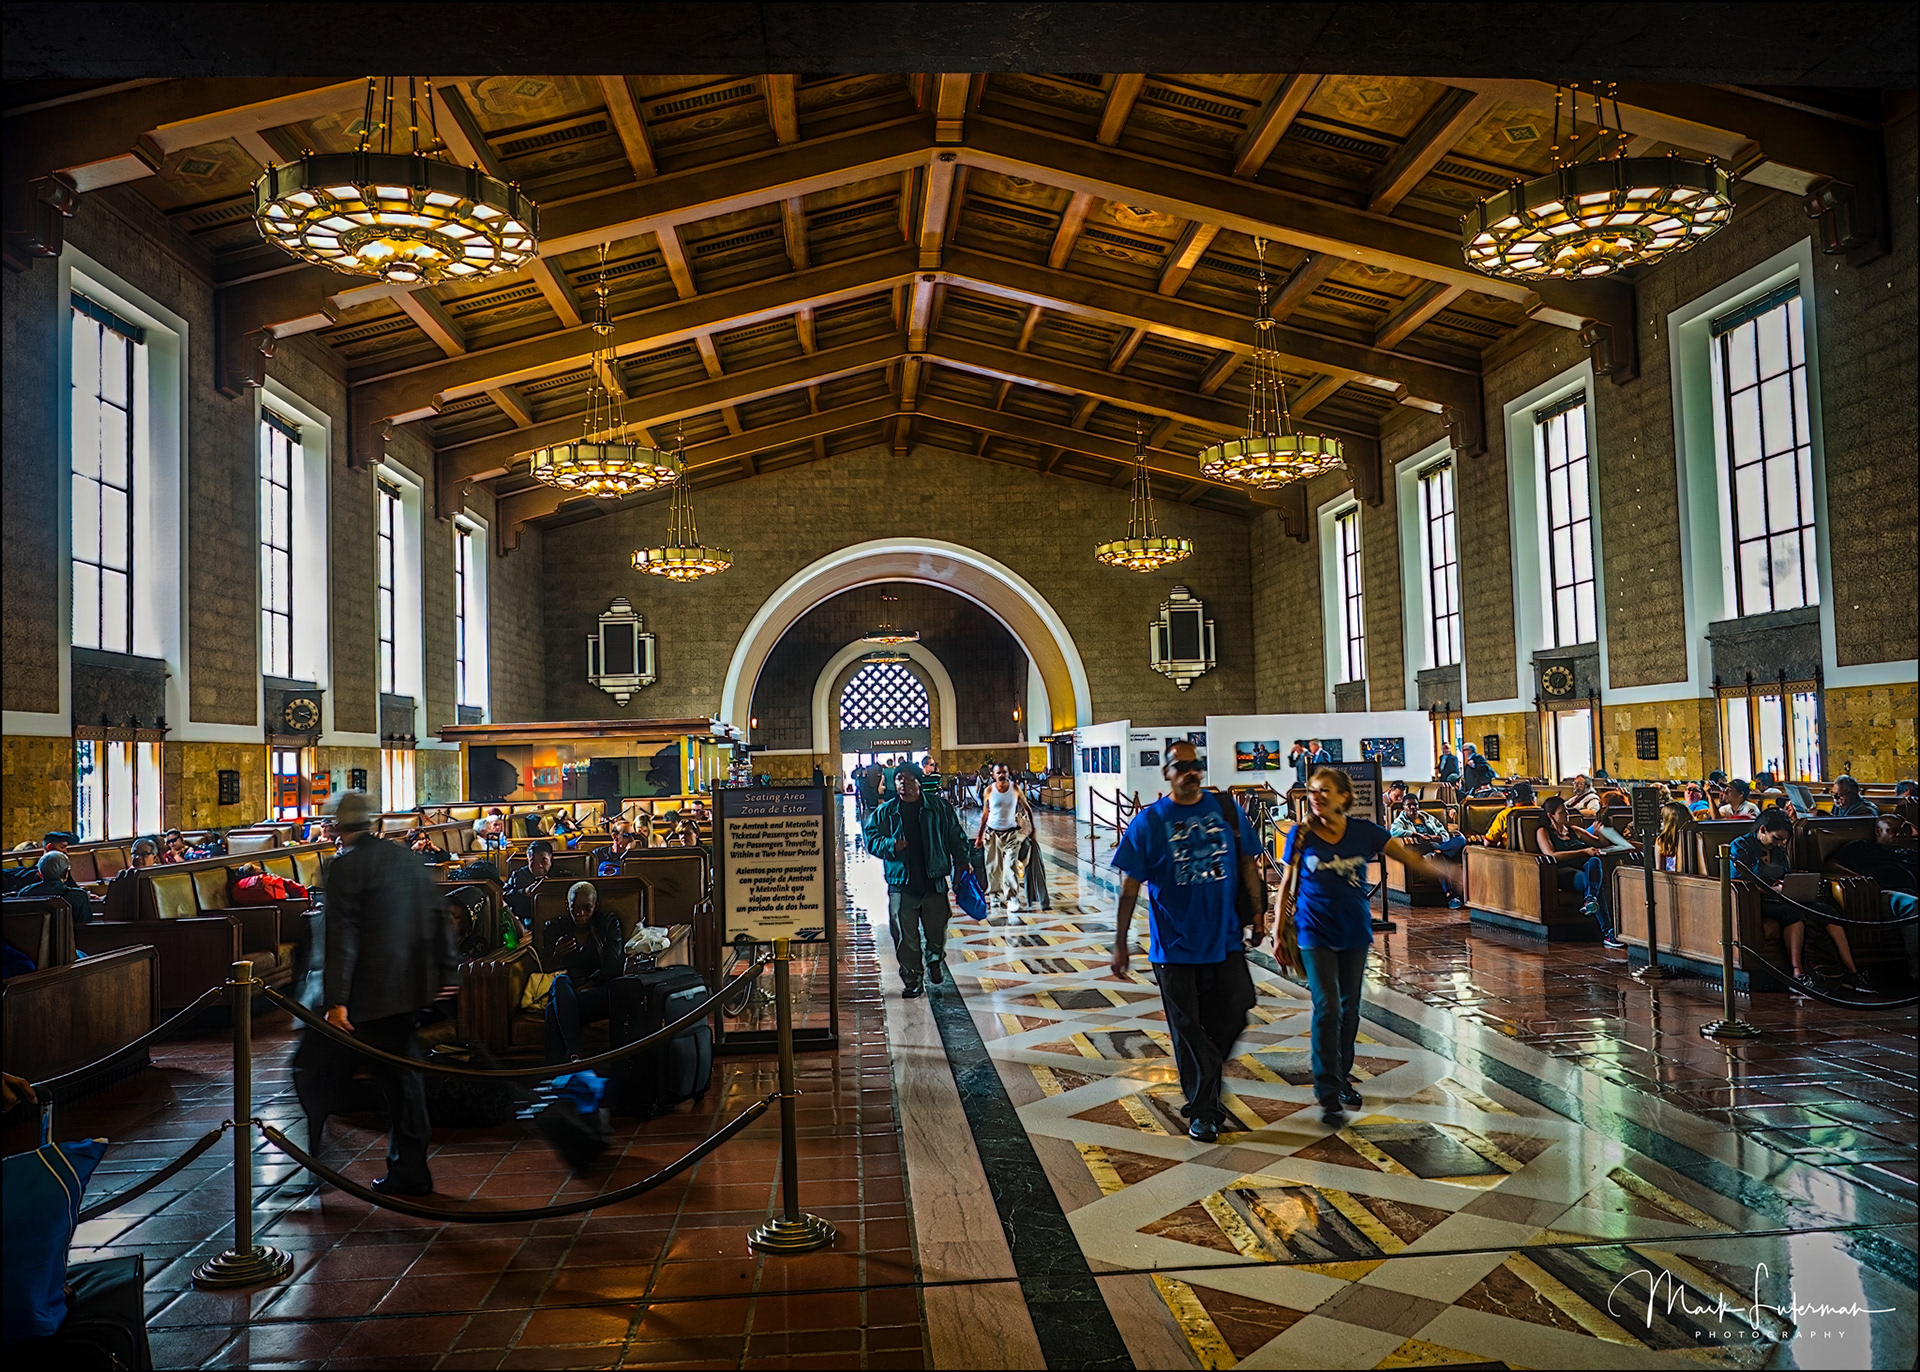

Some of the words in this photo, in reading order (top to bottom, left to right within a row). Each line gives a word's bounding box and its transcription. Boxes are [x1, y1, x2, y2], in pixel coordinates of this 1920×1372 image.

[744, 792, 780, 803] Seating
[783, 792, 805, 800] Area
[741, 806, 765, 814] Zona
[786, 820, 819, 828] Metrolink
[800, 830, 818, 838] Only
[746, 841, 783, 849] Passengers
[785, 839, 816, 848] Traveling
[784, 865, 817, 874] pasajeros
[754, 876, 776, 885] pasaje
[788, 874, 814, 882] Amtrak
[749, 896, 770, 904] viajan
[748, 905, 774, 914] periodo
